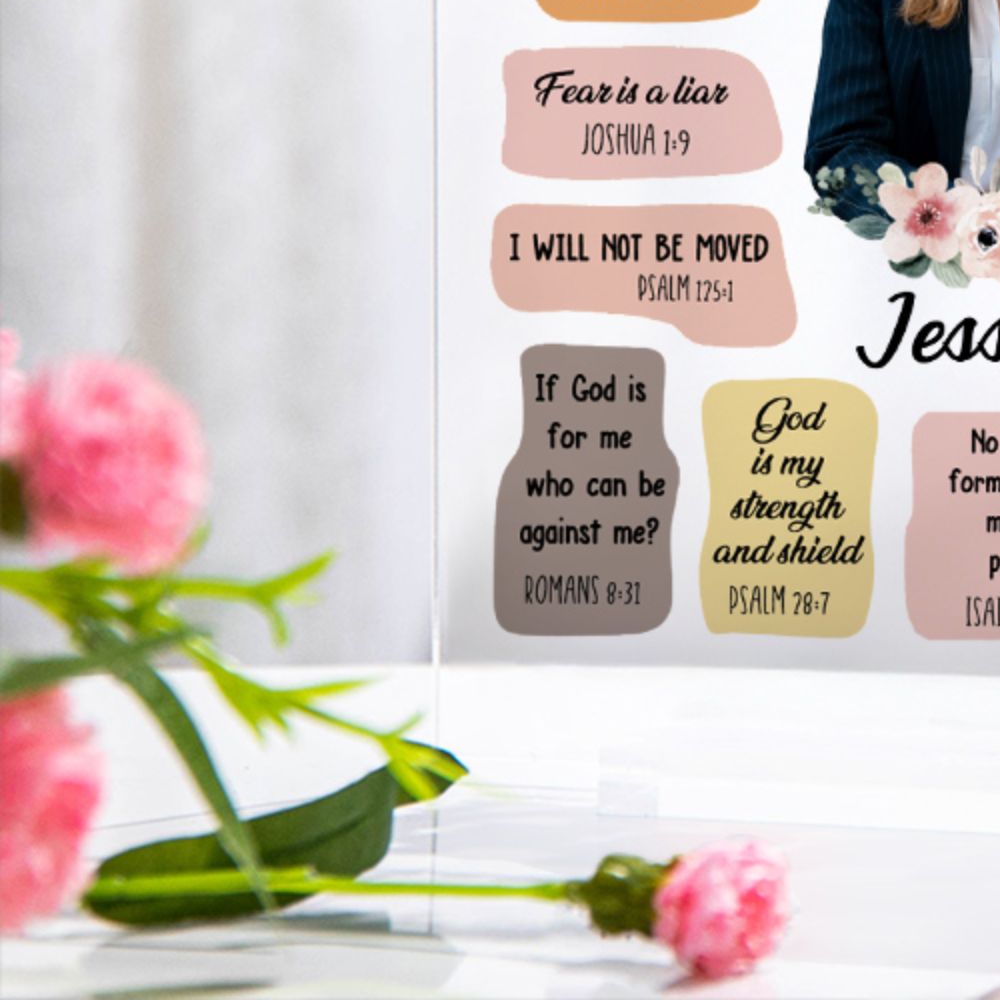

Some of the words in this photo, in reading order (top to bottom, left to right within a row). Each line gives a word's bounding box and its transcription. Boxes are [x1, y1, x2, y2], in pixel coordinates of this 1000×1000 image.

[533, 69, 613, 107] Fear
[615, 76, 639, 105] is
[645, 85, 669, 105] a
[673, 75, 729, 105] liar
[582, 123, 655, 155] JOSHUA
[664, 129, 690, 156] 1:9
[509, 233, 520, 261] I
[532, 233, 590, 262] WILL
[601, 233, 643, 262] NOT
[655, 233, 684, 263] BE
[695, 233, 769, 263] MOVED
[638, 274, 690, 302] PSALM
[697, 280, 733, 302] 125:1
[535, 372, 560, 403] If
[571, 373, 617, 403] God
[628, 373, 647, 403] is
[546, 421, 588, 450] for
[599, 429, 633, 450] me
[751, 397, 827, 445] God
[971, 428, 999, 454] No
[525, 469, 575, 498] who
[586, 477, 628, 498] can
[638, 469, 666, 498] be
[751, 447, 774, 475] is
[780, 456, 825, 489] my
[729, 490, 845, 533] strength
[519, 516, 602, 553] against
[613, 516, 660, 545] me?
[712, 535, 776, 564] and
[776, 535, 865, 565] shield
[524, 574, 599, 605] ROMANS
[606, 581, 641, 605] 8:31
[729, 585, 786, 615] PSALM
[793, 591, 830, 615] 28:7
